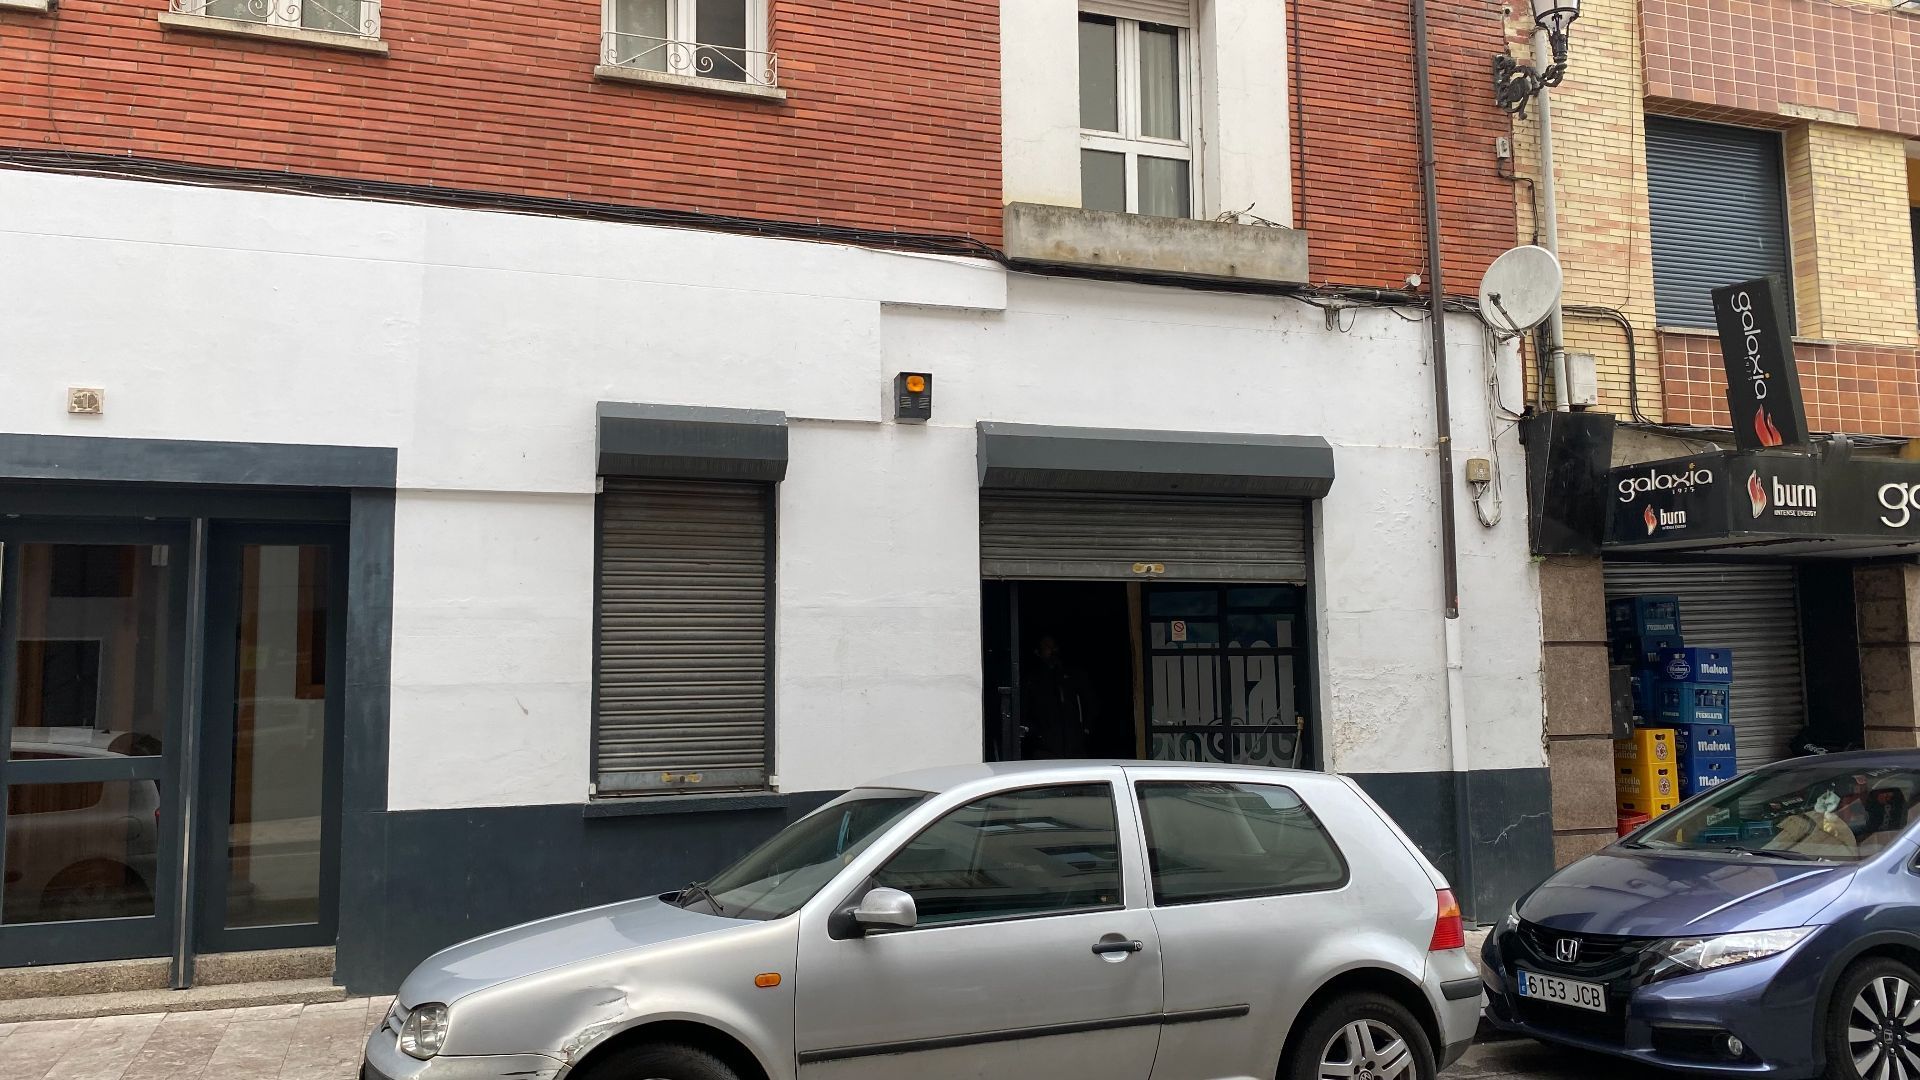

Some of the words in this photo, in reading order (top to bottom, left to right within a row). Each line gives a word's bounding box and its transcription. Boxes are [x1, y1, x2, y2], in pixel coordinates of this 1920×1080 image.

[1731, 291, 1769, 400] galaxia
[1618, 462, 1713, 503] galaxia
[1672, 486, 1696, 495] 1975
[1773, 475, 1817, 508] burn
[1660, 508, 1687, 526] burn
[1701, 663, 1729, 675] Mahou
[1697, 740, 1731, 752] Mahou
[1699, 775, 1728, 787] Mah
[1528, 975, 1567, 1001] 6153
[1572, 984, 1601, 1008] JCB
